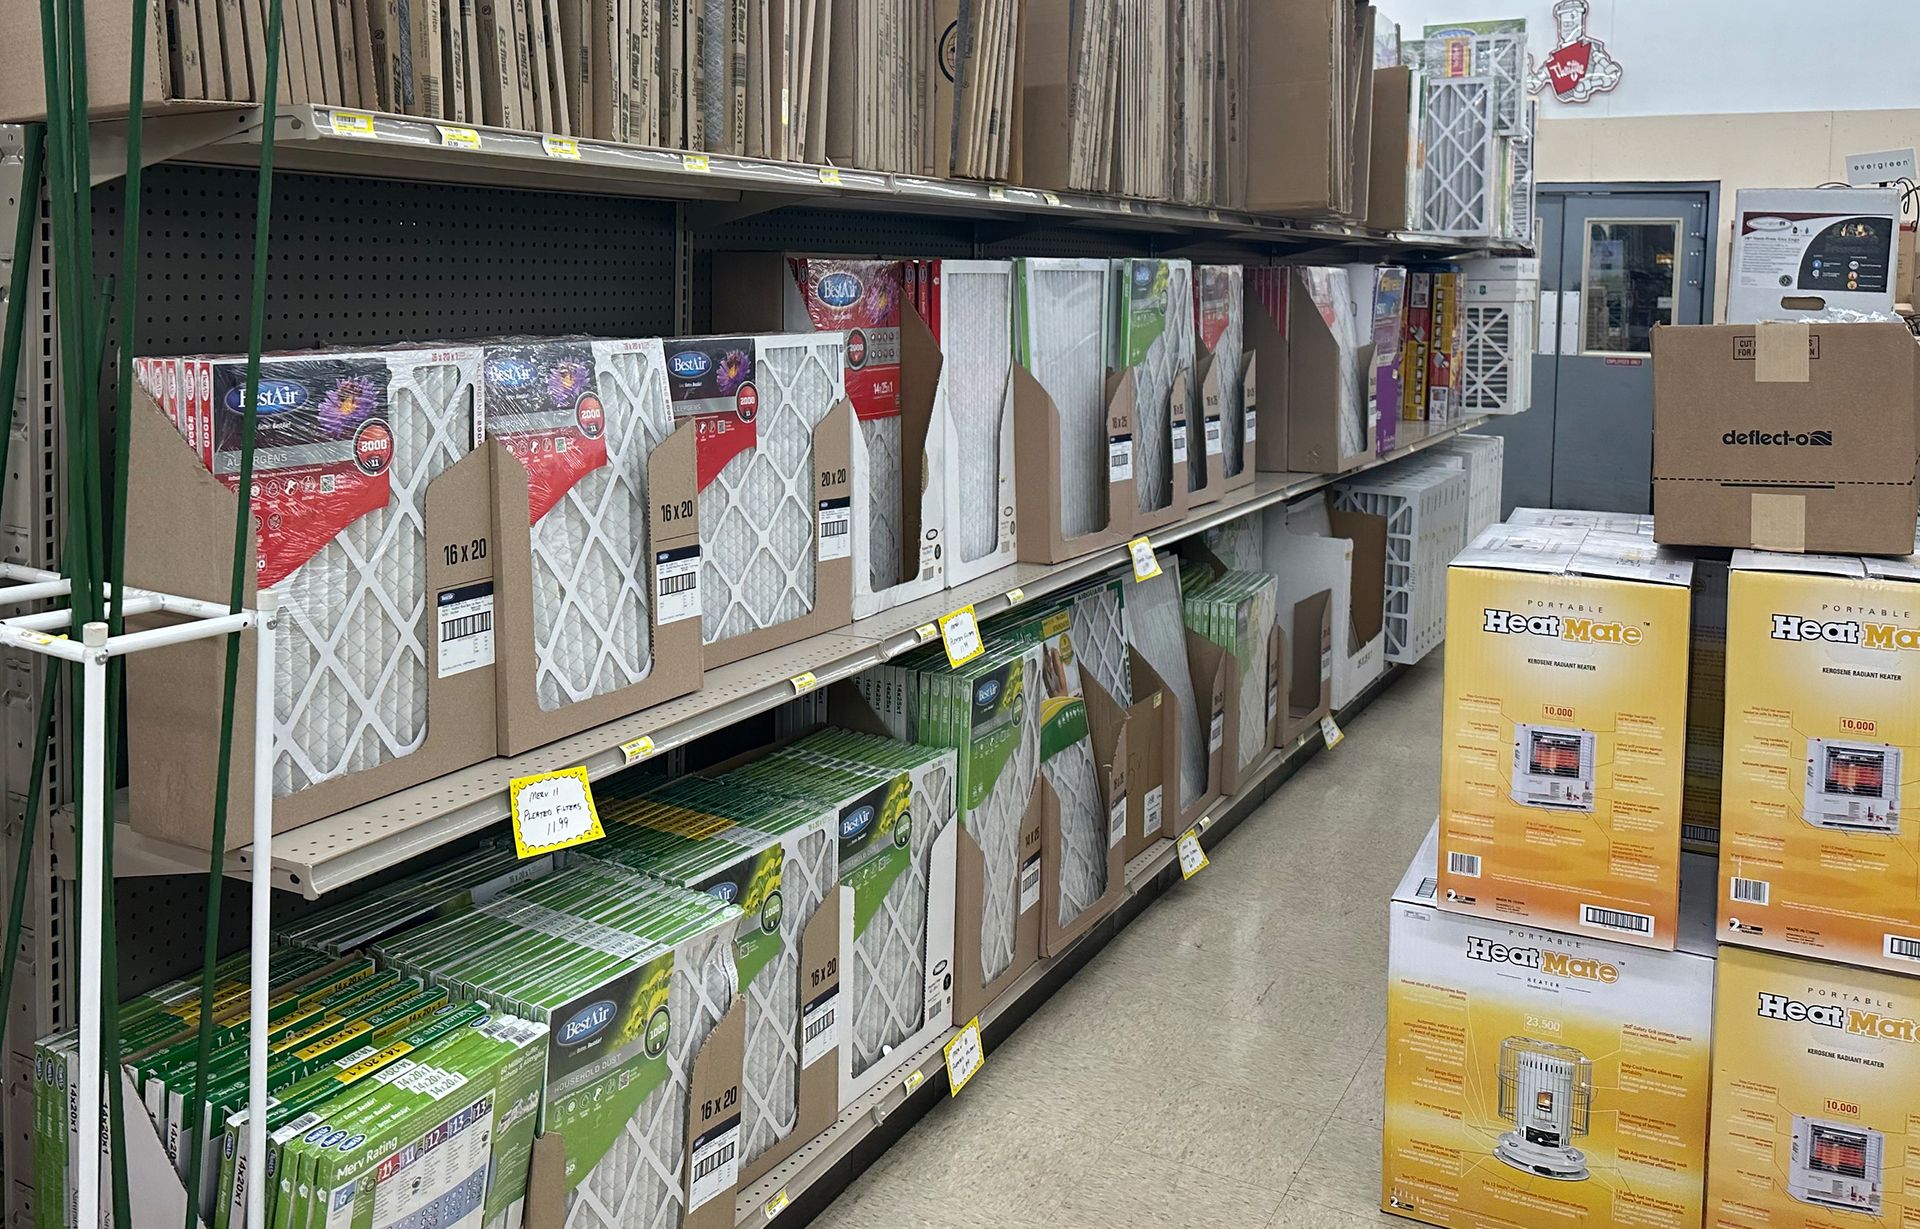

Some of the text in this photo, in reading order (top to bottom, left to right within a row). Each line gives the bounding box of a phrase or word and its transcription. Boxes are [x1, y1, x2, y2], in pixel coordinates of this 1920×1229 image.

[1854, 160, 1910, 172] evergreen
[824, 280, 858, 298] BestAir
[1740, 340, 1754, 348] CUT
[490, 364, 533, 382] BestAir
[674, 356, 706, 372] BestAir
[740, 396, 755, 406] 2000
[582, 409, 600, 420] 2000
[1722, 430, 1809, 446] deflect-o
[226, 454, 288, 467] ALRGENS
[822, 472, 830, 486] 20
[837, 468, 846, 484] 20
[662, 504, 671, 522] 16
[680, 500, 693, 518] 20
[444, 546, 458, 566] 16
[471, 539, 487, 560] 20
[1528, 599, 1604, 613] PORTABLE
[1822, 604, 1910, 619] PORTABLE
[1483, 608, 1644, 646] Heat Mate
[1771, 614, 1920, 650] Heat Ma
[1528, 658, 1596, 672] KEROSENE RADIANT HEATER
[1822, 666, 1902, 682] KEROSENE RADIANT HEATER
[1544, 706, 1572, 718] 10,000
[1842, 718, 1875, 732] 10,000
[523, 808, 552, 823] PLEATED
[843, 810, 870, 834] BestAir
[1448, 889, 1457, 901] 2
[1730, 918, 1740, 932] 2
[1508, 930, 1581, 948] PORTABLE
[1467, 936, 1619, 984] Heat Mate
[811, 969, 819, 986] 16
[828, 957, 837, 975] 20
[1528, 978, 1560, 988] HEATER
[1808, 987, 1894, 1009] PORTABLE
[1758, 992, 1843, 1028] Heat
[565, 1006, 610, 1041] BestAir
[650, 1022, 667, 1040] 1000
[1526, 1016, 1560, 1032] 23,500
[364, 1058, 379, 1068] 20
[1808, 1048, 1885, 1069] KEROSENE RADIANT HEATER
[378, 1060, 412, 1080] 14x20x1
[398, 1066, 430, 1087] 14x20x1
[554, 1053, 622, 1094] HOUSEHOLD DUST
[414, 1070, 446, 1092] 14x20x1
[430, 1074, 464, 1096] 14x20x1
[70, 1082, 78, 1134] 14x20x1
[476, 1100, 485, 1116] 13
[701, 1100, 712, 1122] 16
[723, 1086, 738, 1109] 20
[1826, 1100, 1858, 1114] 10,000
[101, 1104, 109, 1154] 14x20x1
[452, 1114, 464, 1132] 13
[428, 1130, 440, 1148] 12
[337, 1136, 398, 1180] Merv Rating
[406, 1148, 414, 1166] 11
[382, 1160, 392, 1180] 11
[235, 1154, 248, 1208] 14x20x1
[340, 1190, 347, 1204] 6
[1390, 1196, 1399, 1207] 2
